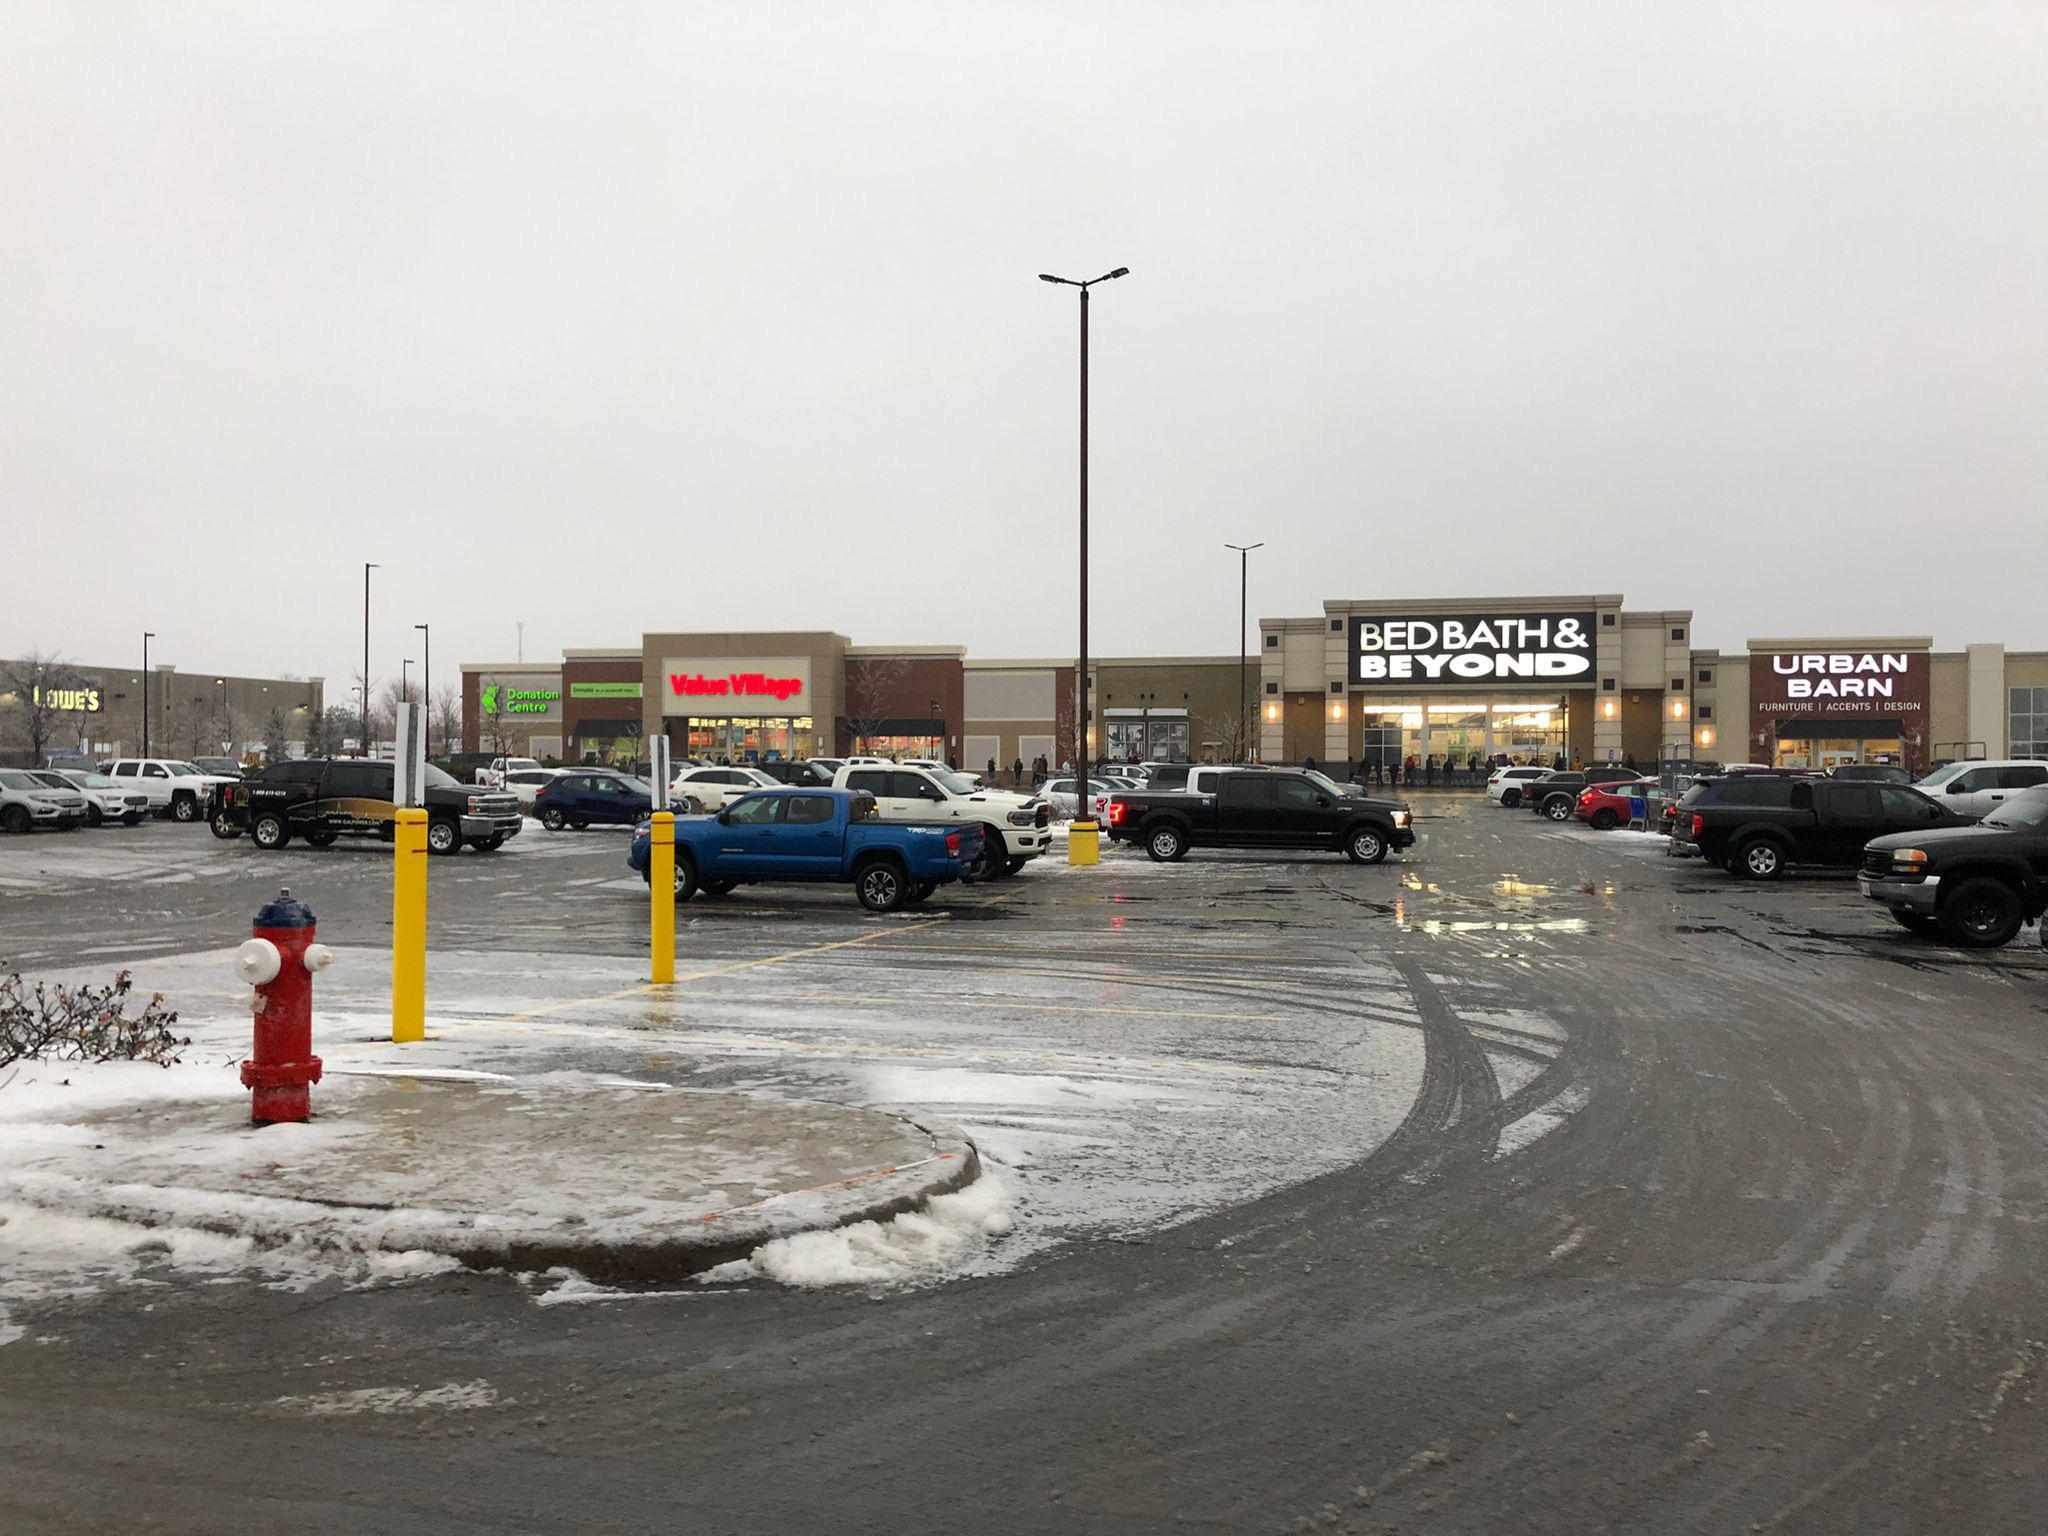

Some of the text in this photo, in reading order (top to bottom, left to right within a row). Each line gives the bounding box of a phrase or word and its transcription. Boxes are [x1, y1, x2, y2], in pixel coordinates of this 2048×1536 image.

[1360, 617, 1589, 651] BED BATH &
[1359, 652, 1590, 679] BEYOND
[1773, 654, 1907, 674] URBAN
[507, 688, 560, 700] Donation
[669, 672, 803, 701] Value Village
[1787, 677, 1893, 698] BARN
[507, 701, 548, 712] Centre
[1759, 702, 1920, 712] FURNITURE ACCENTS DESIGN
